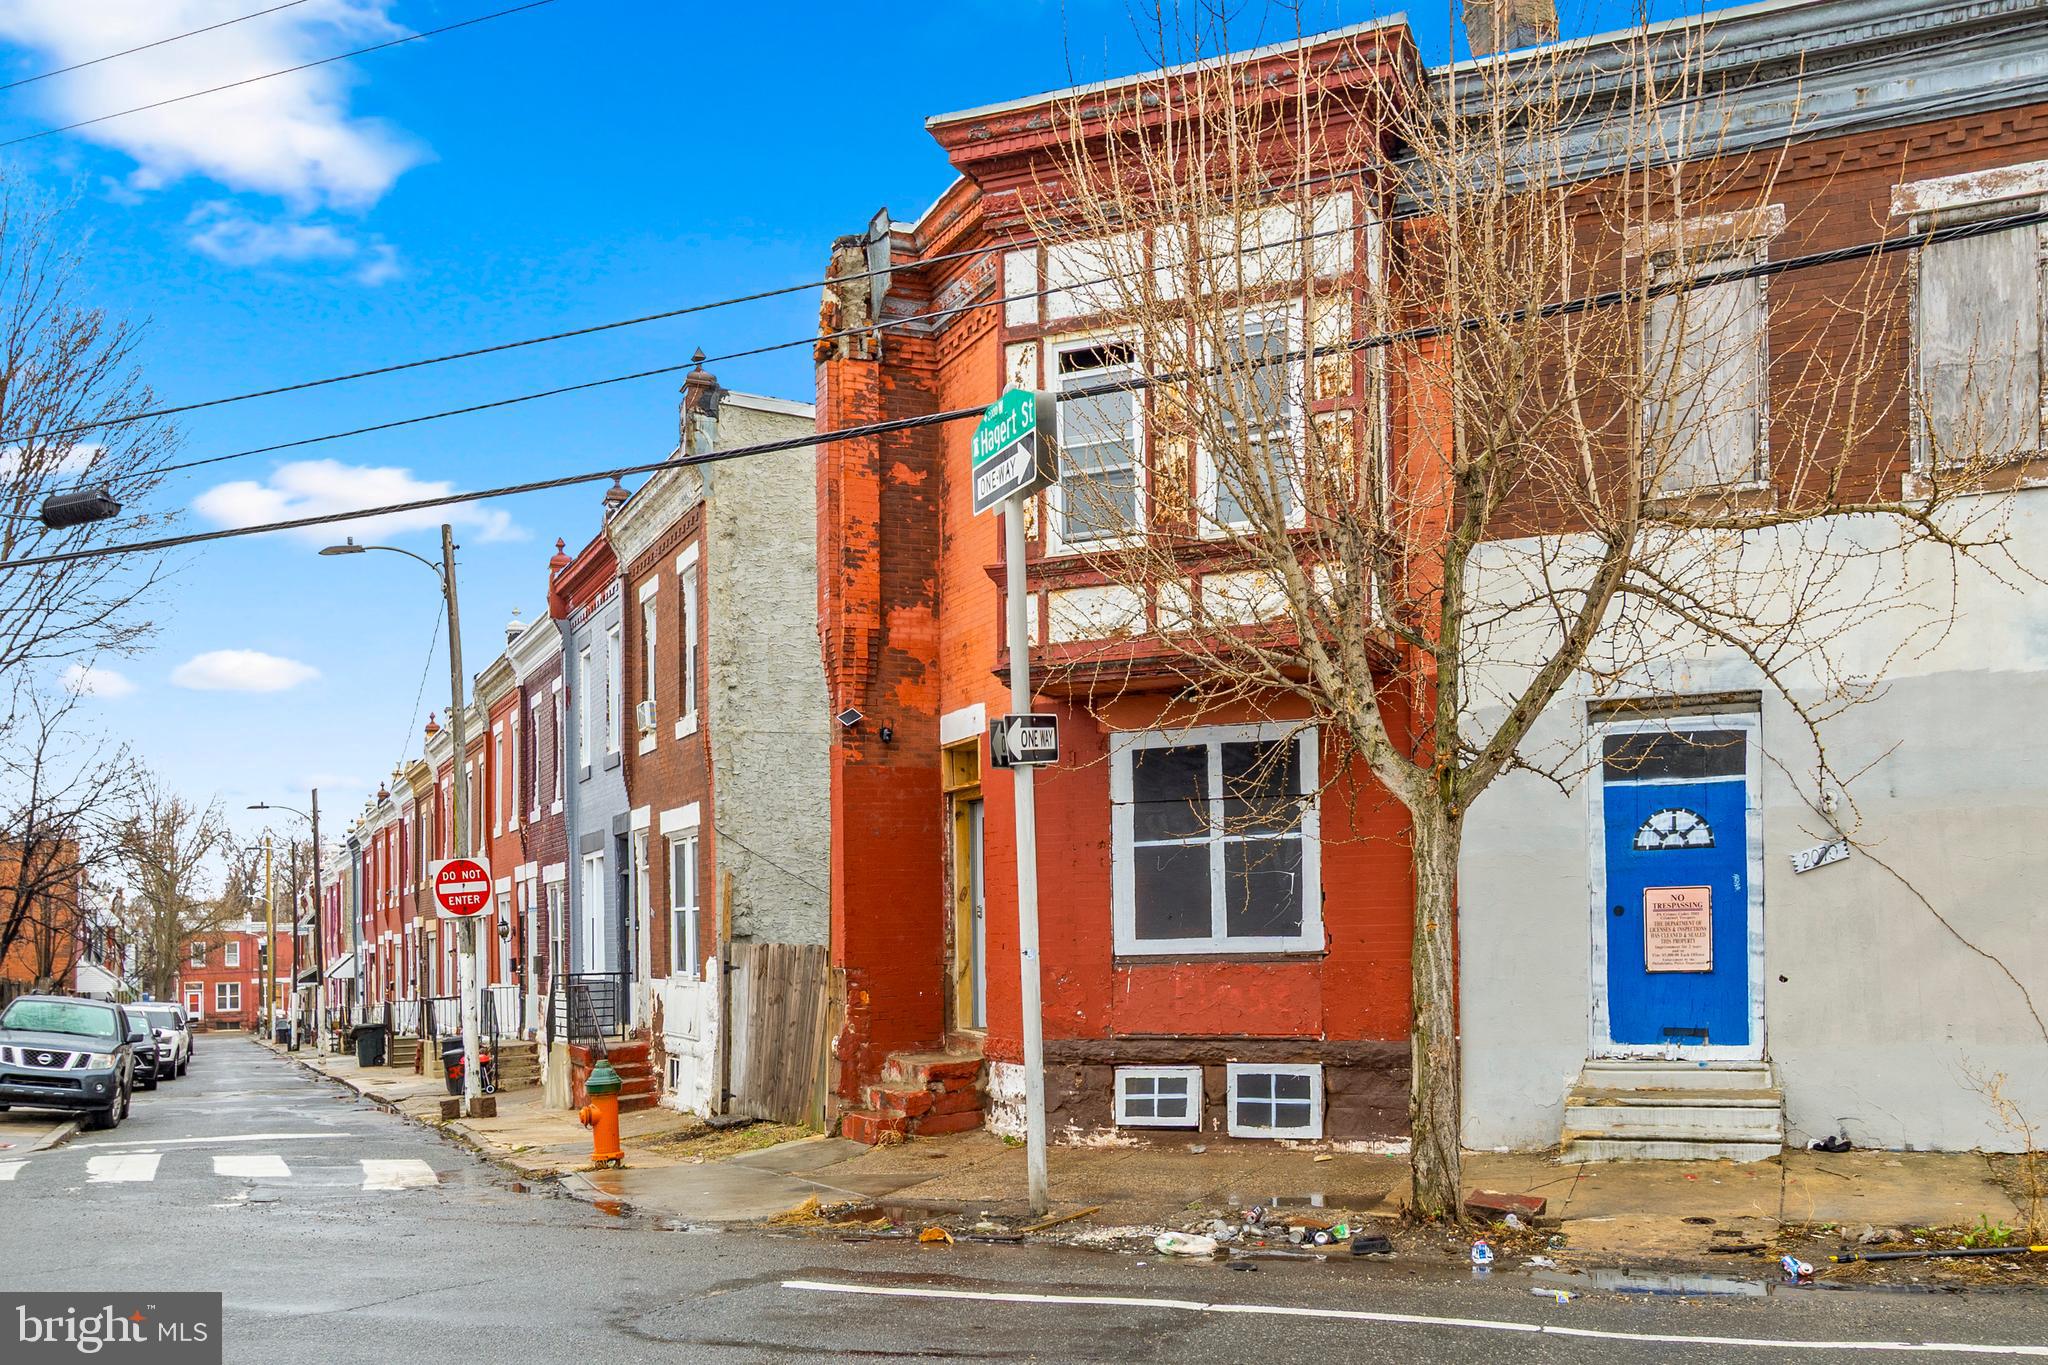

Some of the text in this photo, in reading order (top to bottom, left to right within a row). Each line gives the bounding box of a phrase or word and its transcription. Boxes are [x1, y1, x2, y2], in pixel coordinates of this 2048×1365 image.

[980, 397, 1034, 457] Hagert St
[1021, 730, 1039, 748] ONE
[1040, 730, 1053, 748] WAY
[442, 869, 481, 881] DO NOT
[448, 894, 481, 906] ENTER
[1671, 894, 1685, 902] NO
